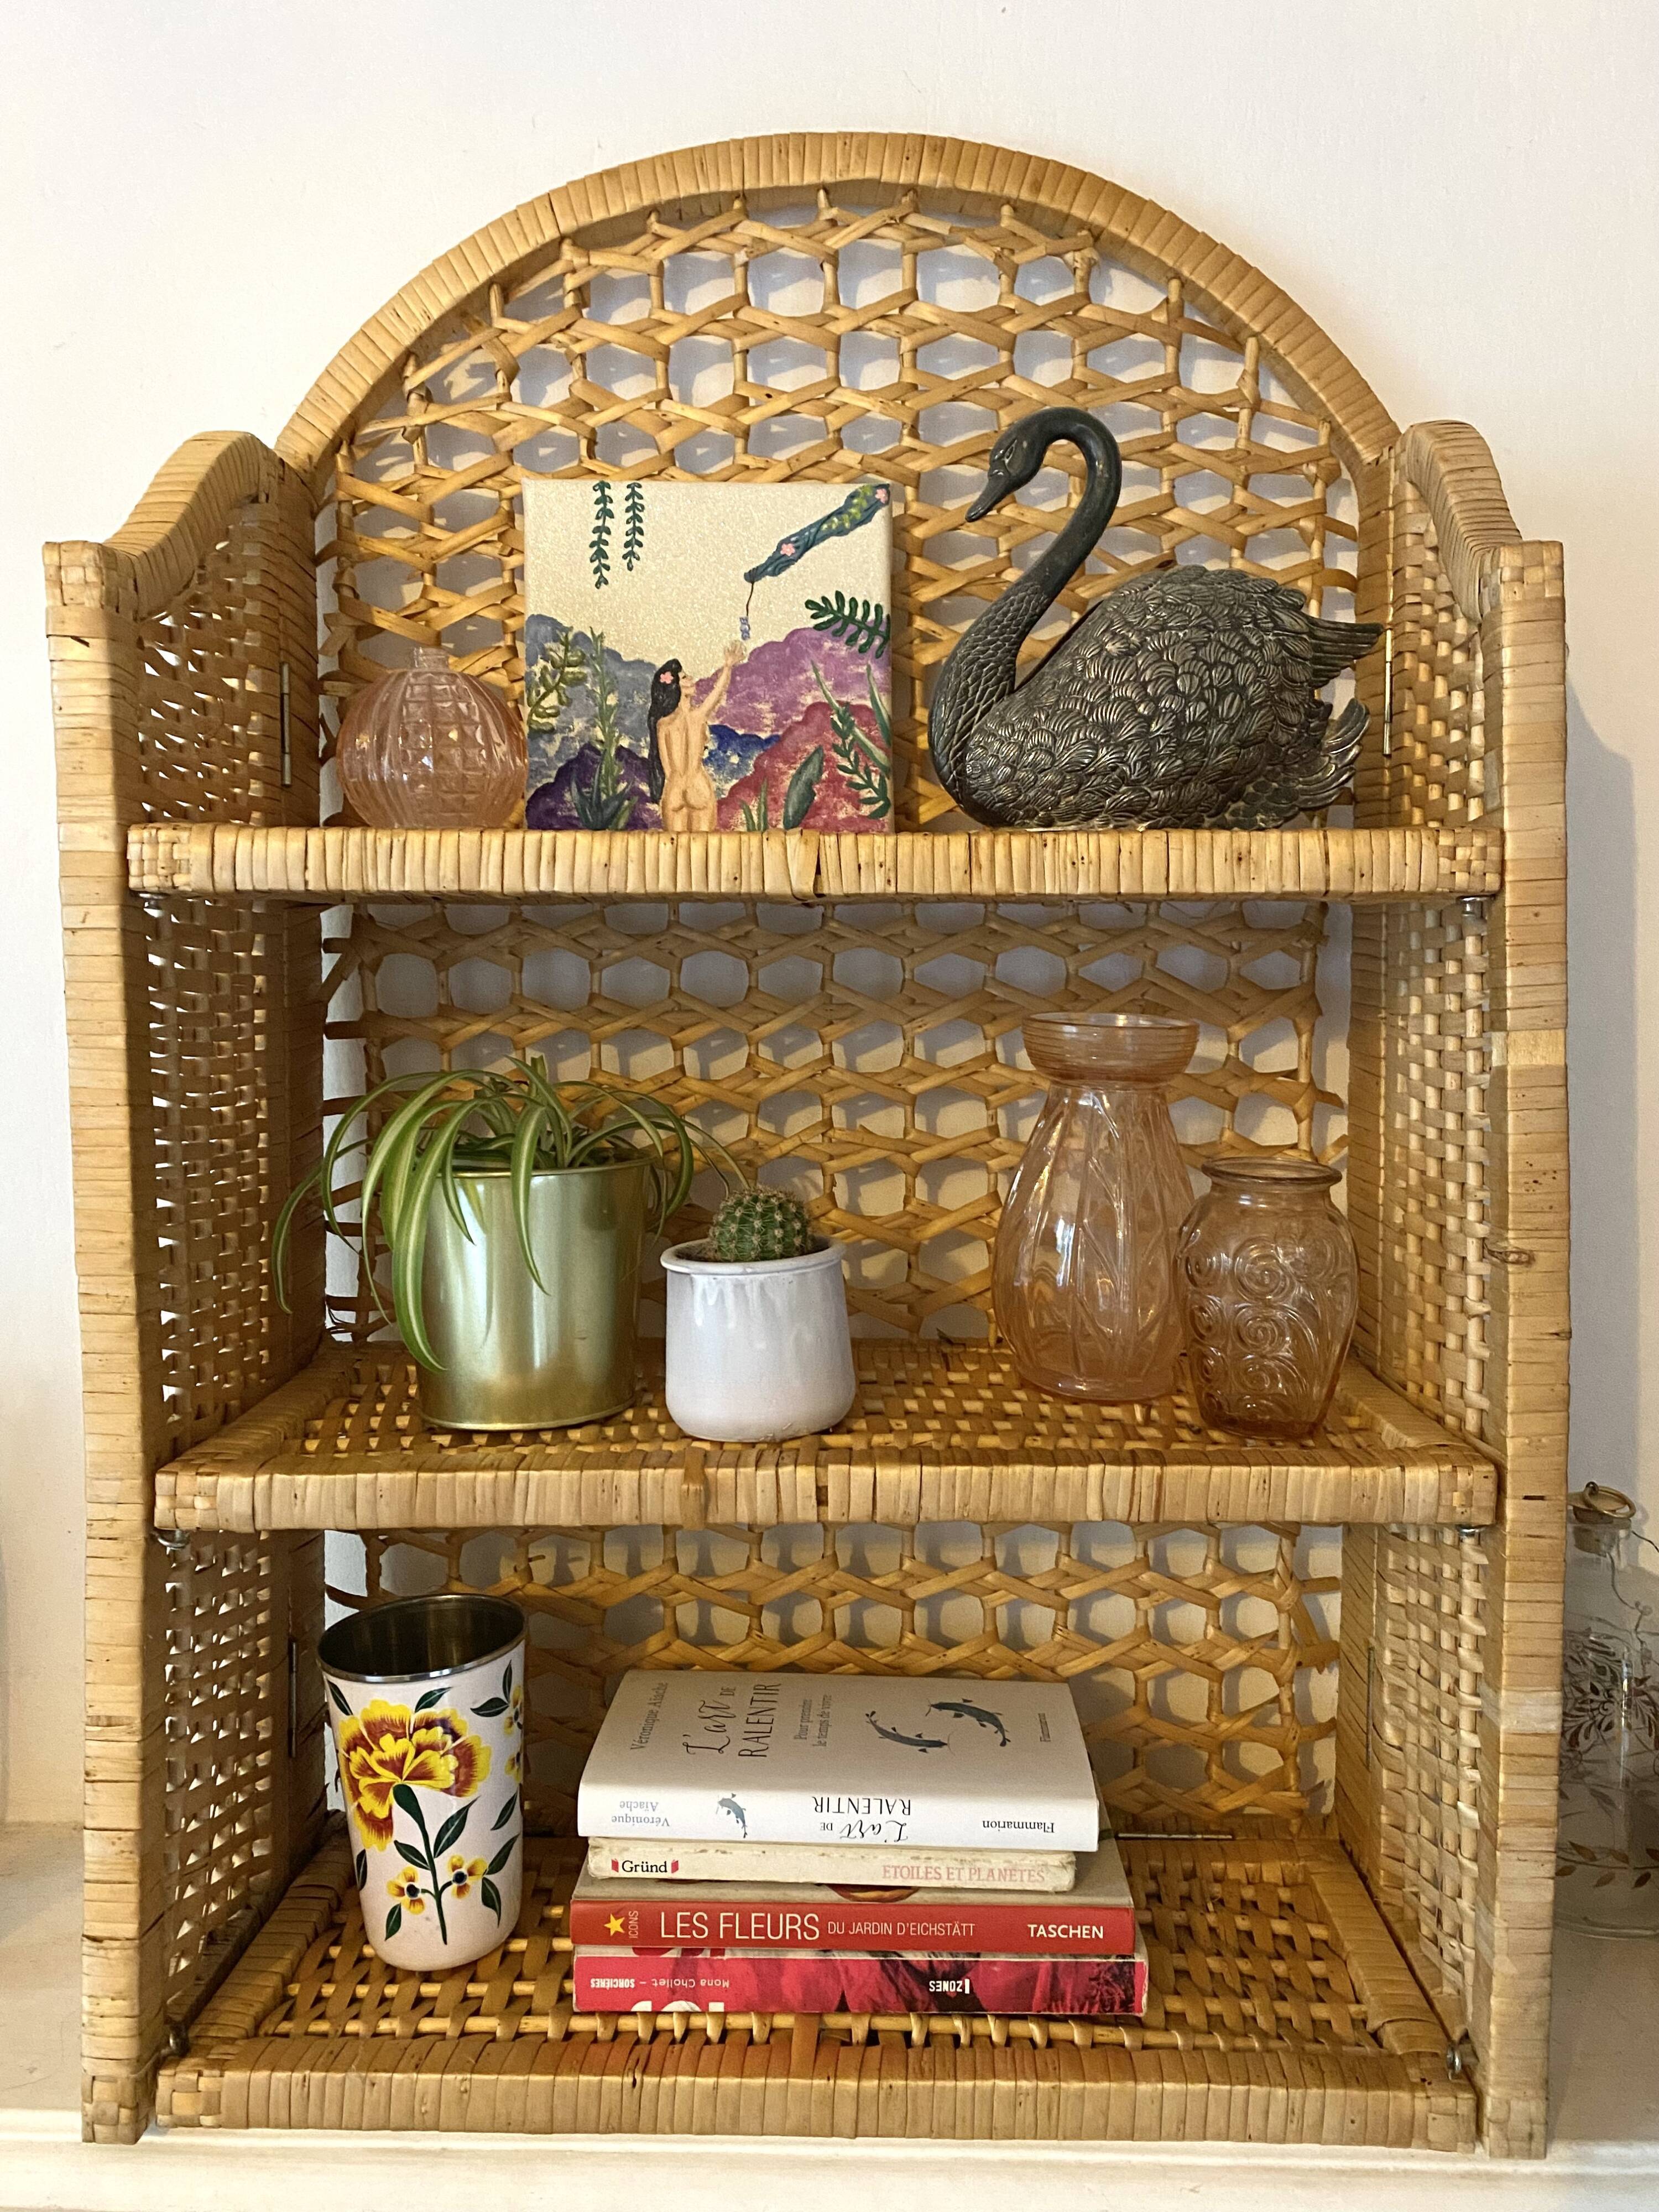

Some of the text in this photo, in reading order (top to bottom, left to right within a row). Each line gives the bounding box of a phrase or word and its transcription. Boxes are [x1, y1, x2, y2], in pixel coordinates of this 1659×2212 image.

[719, 1686, 736, 1697] DE
[738, 1683, 781, 1757] RALENTIR
[630, 1709, 659, 1750] Véronique
[794, 1724, 808, 1740] Pour
[619, 1800, 659, 1812] Aïache
[811, 1796, 911, 1815] RALENTIR
[611, 1815, 670, 1827] Véronique
[820, 1822, 834, 1832] DE
[982, 1820, 1055, 1834] Flammarion
[622, 1860, 667, 1874] Gründ
[946, 1866, 964, 1881] ET
[628, 1911, 639, 1939] ICONS
[661, 1911, 975, 1940] LES FLEURS DU JARDIN D'EICHSTÄTT
[1027, 1924, 1104, 1939] TASCHEN
[590, 1978, 635, 1990] SORCIÈRES
[651, 1978, 696, 1988] Chollet
[700, 1979, 729, 1988] Mona
[929, 1980, 963, 1993] ZONES
